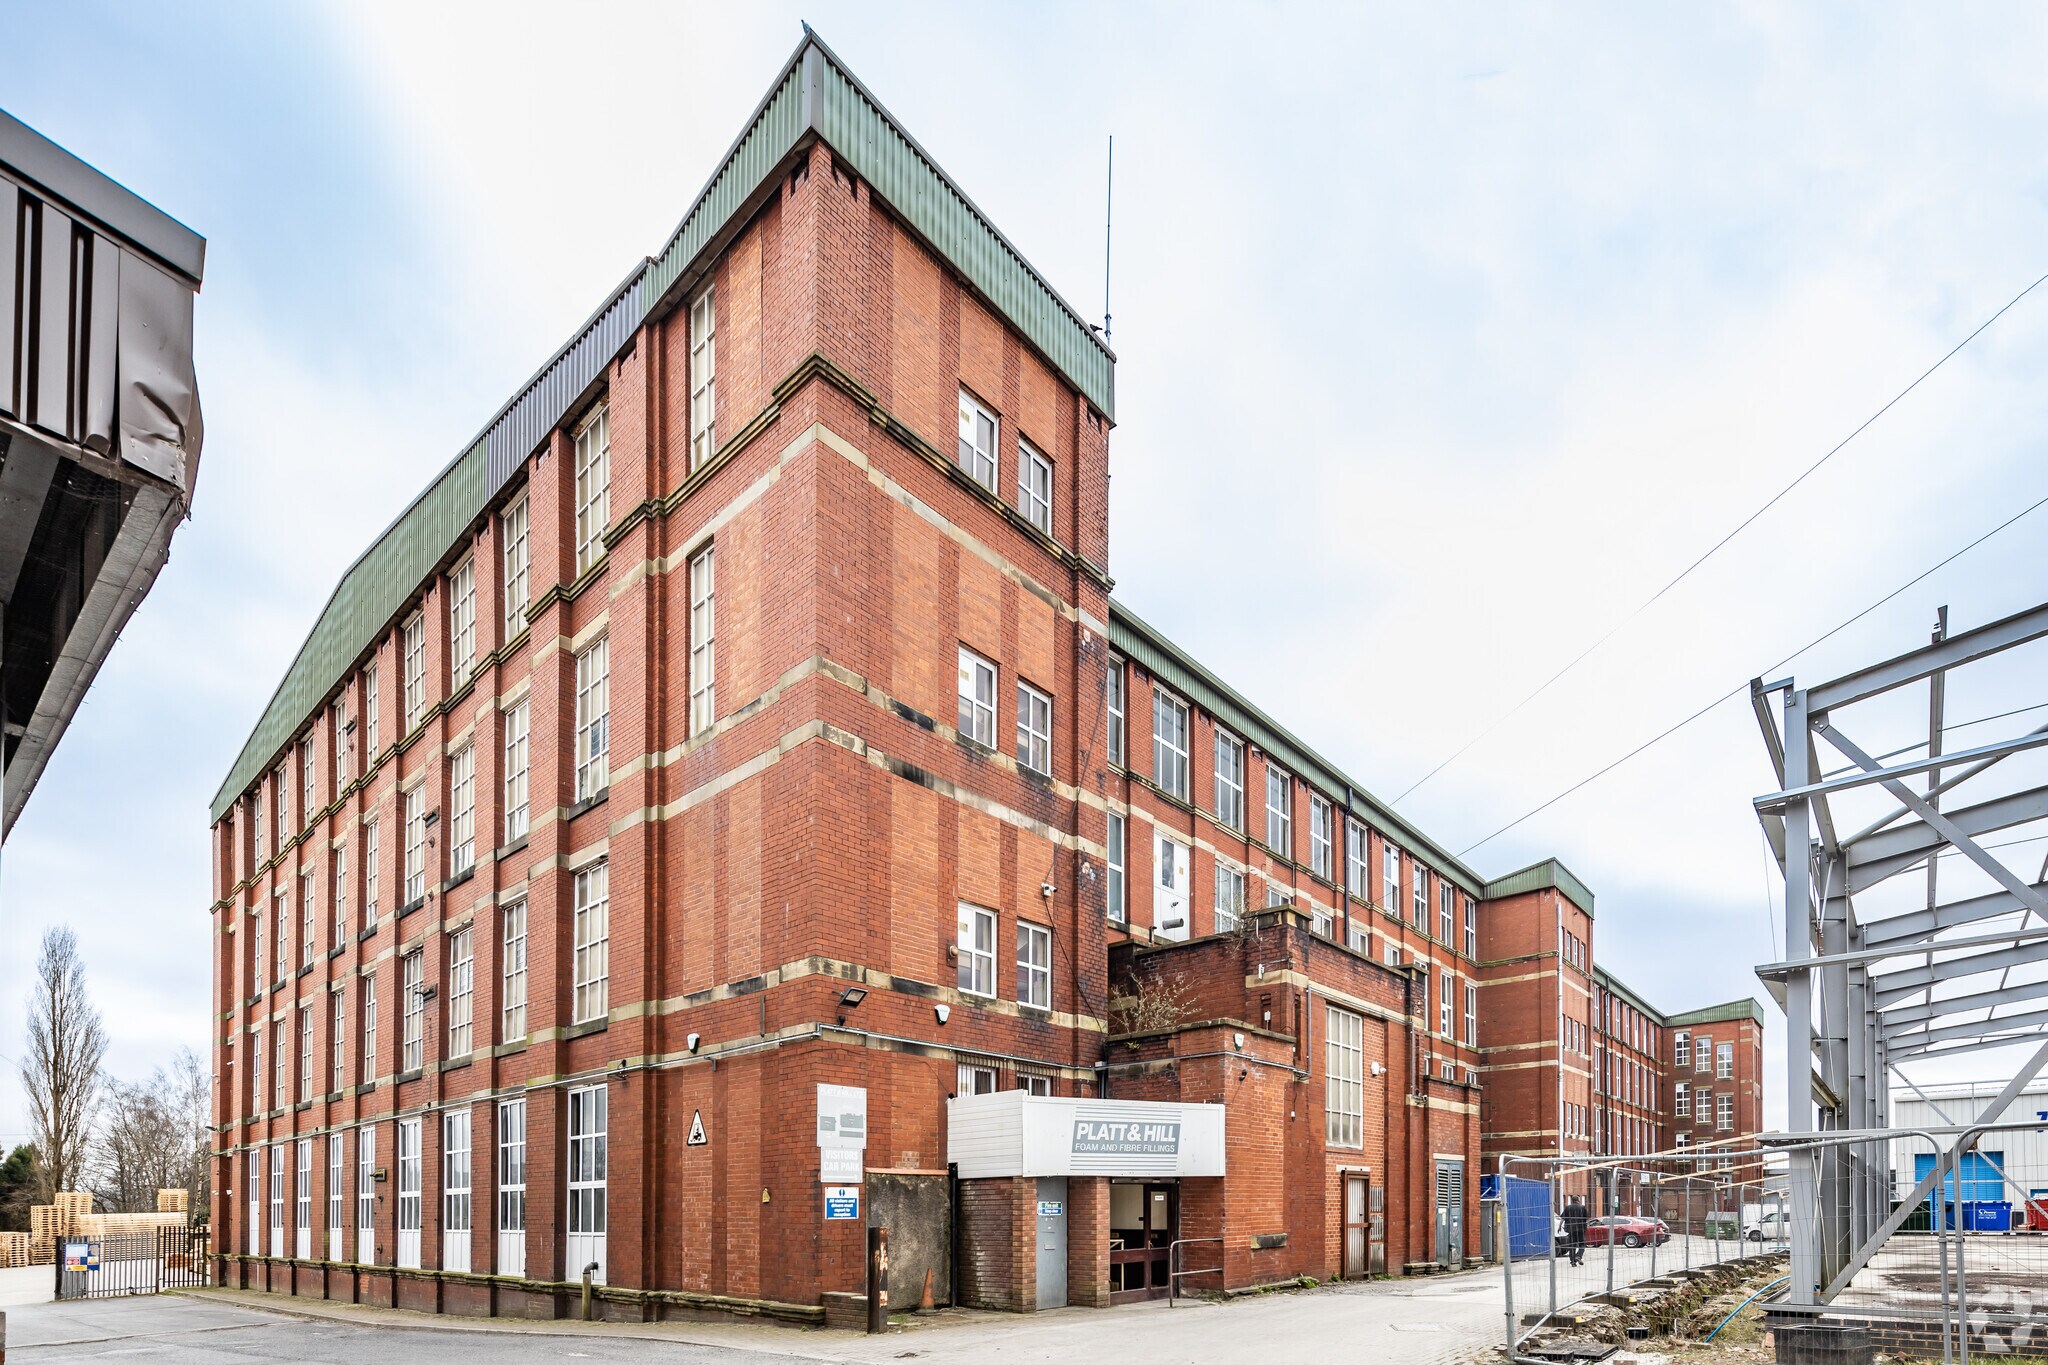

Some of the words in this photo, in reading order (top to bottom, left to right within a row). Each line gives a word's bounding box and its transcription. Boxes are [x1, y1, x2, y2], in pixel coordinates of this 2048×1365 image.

[1075, 1142, 1099, 1151] FOAM
[1100, 1143, 1117, 1152] AND
[1119, 1143, 1141, 1152] FIBRE
[1143, 1144, 1175, 1153] FILLINGS
[825, 1149, 859, 1161] VISITORS
[823, 1161, 839, 1171] CAR
[840, 1161, 860, 1172] PARK
